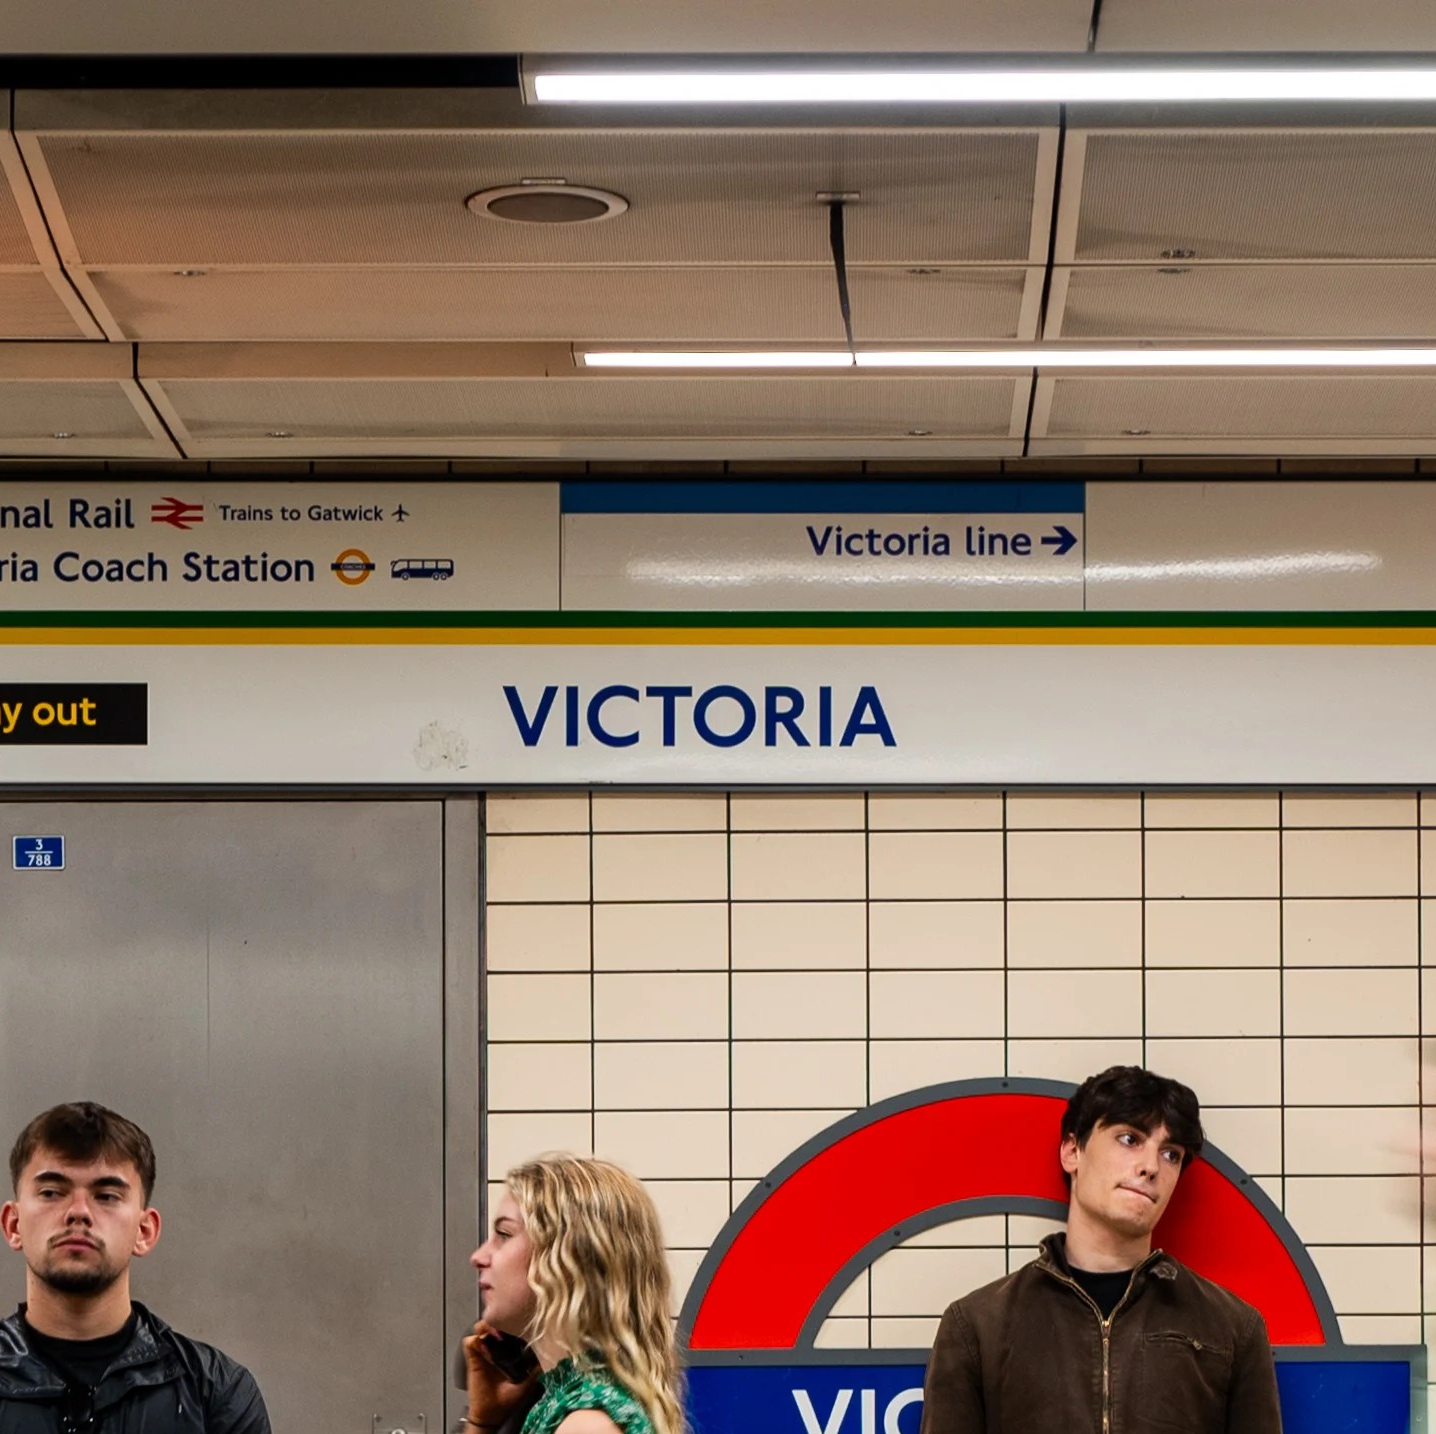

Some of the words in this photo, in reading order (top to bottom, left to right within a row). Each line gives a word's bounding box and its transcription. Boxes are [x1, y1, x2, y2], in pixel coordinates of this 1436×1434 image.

[69, 498, 135, 529] Rail
[218, 504, 274, 521] Trains
[280, 506, 301, 521] to
[307, 504, 383, 521] Gatwick
[806, 525, 950, 556] Victoria
[966, 525, 1032, 556] line
[53, 551, 168, 582] Coach
[182, 551, 314, 582] Station
[32, 697, 97, 726] out
[502, 684, 897, 748] VICTORIA
[35, 838, 43, 851] 3
[28, 854, 52, 866] 788
